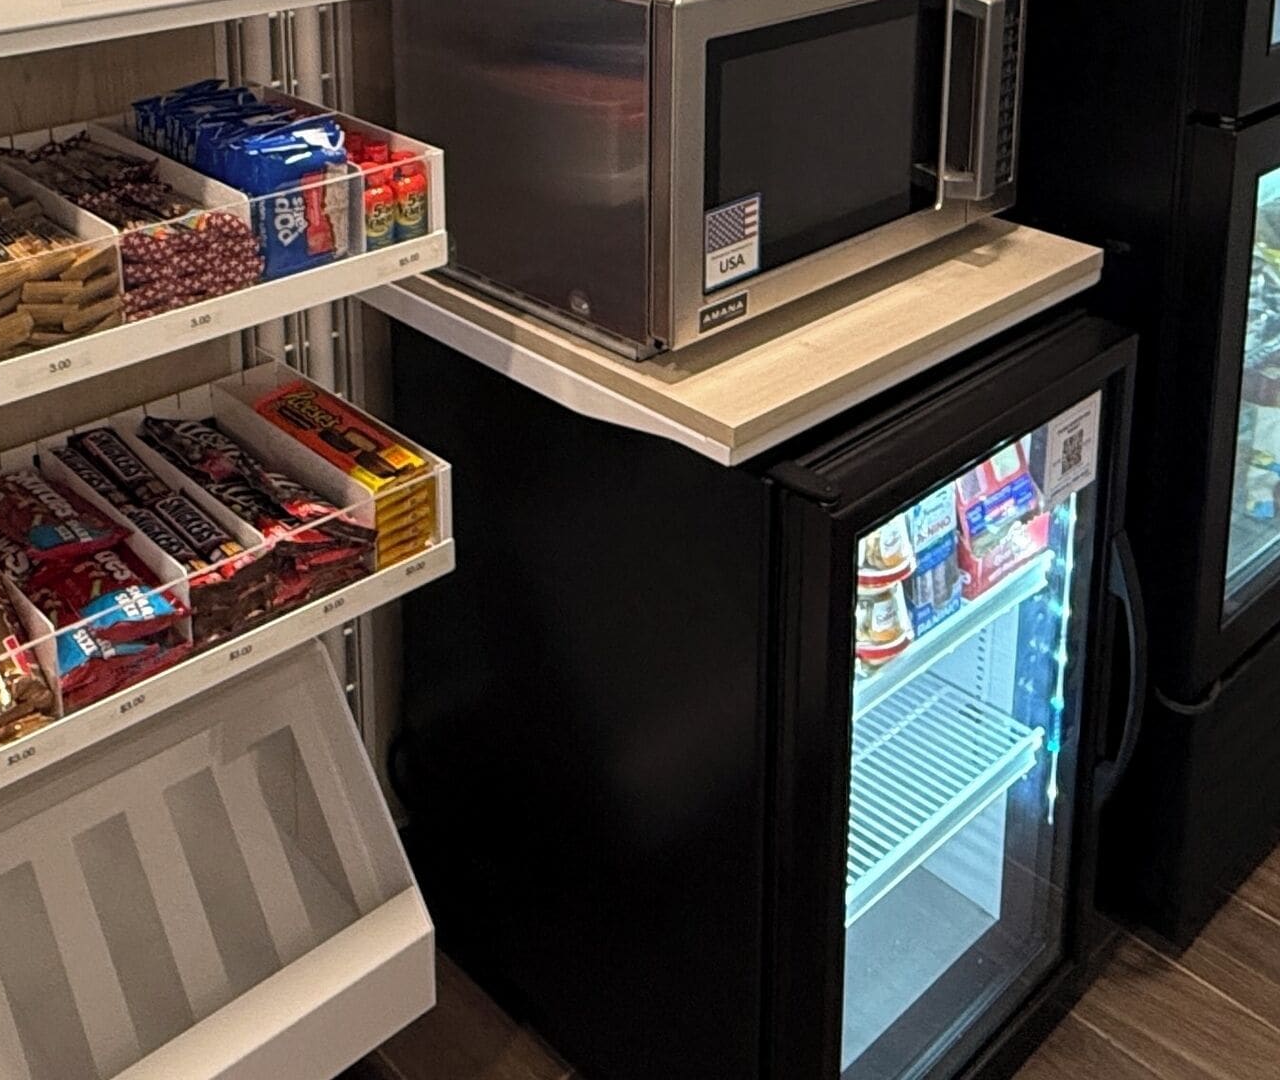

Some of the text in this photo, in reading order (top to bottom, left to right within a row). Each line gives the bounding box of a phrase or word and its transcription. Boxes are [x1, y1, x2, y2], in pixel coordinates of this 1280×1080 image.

[274, 197, 300, 247] POP
[719, 253, 745, 273] USA
[703, 300, 744, 322] AMANA
[49, 358, 72, 374] 3.00
[72, 628, 98, 656] SIZE
[120, 694, 146, 714] $3.00
[7, 747, 36, 766] $3.00
